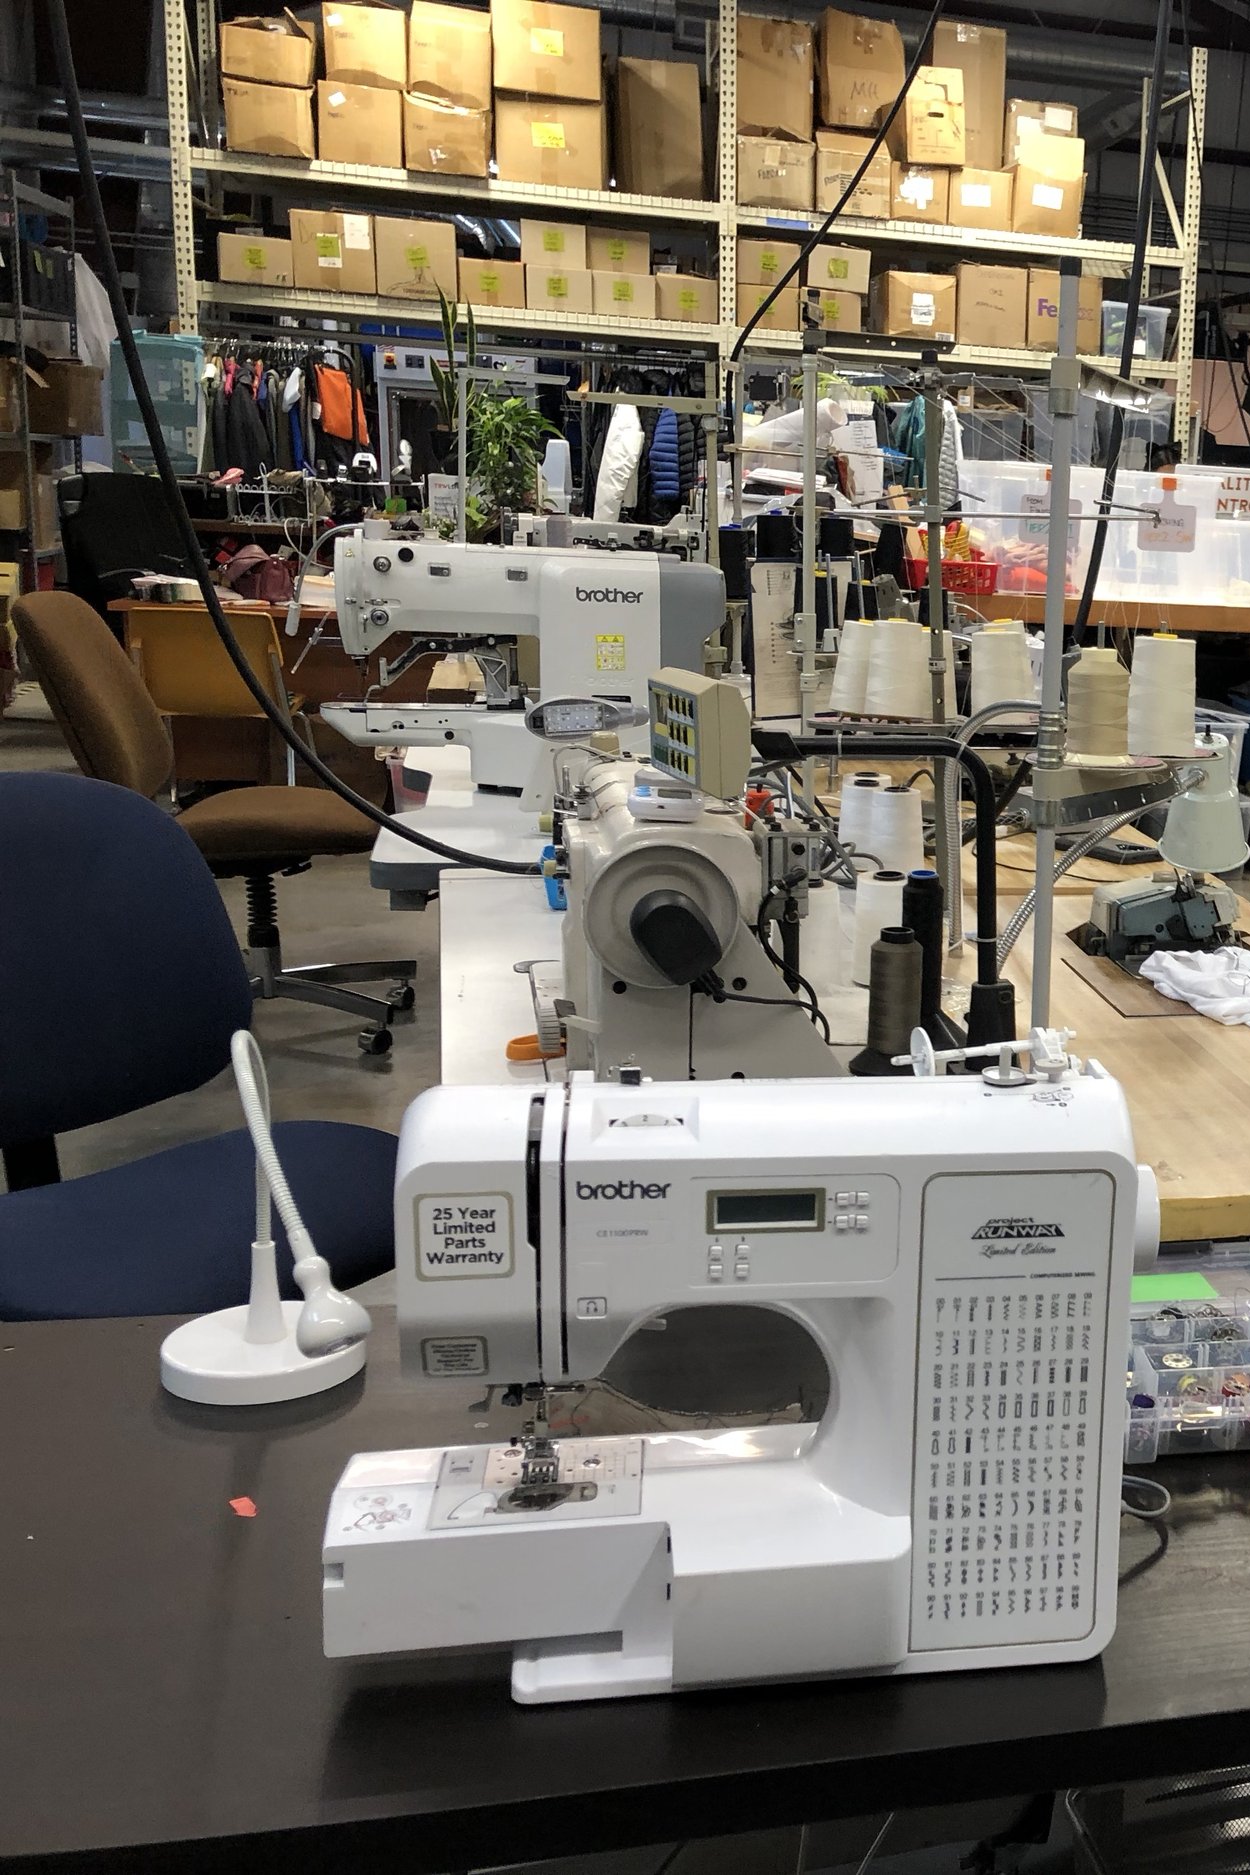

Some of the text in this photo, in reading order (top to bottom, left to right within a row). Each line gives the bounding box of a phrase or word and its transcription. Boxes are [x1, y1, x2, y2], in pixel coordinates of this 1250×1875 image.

[576, 586, 644, 603] brother
[576, 1180, 672, 1200] brother
[432, 1207, 496, 1220] 25 Year
[433, 1221, 496, 1235] Limited
[985, 1217, 1034, 1226] project
[973, 1225, 1060, 1238] RUNWAY
[444, 1237, 486, 1249] Parts
[426, 1251, 504, 1264] Warranty
